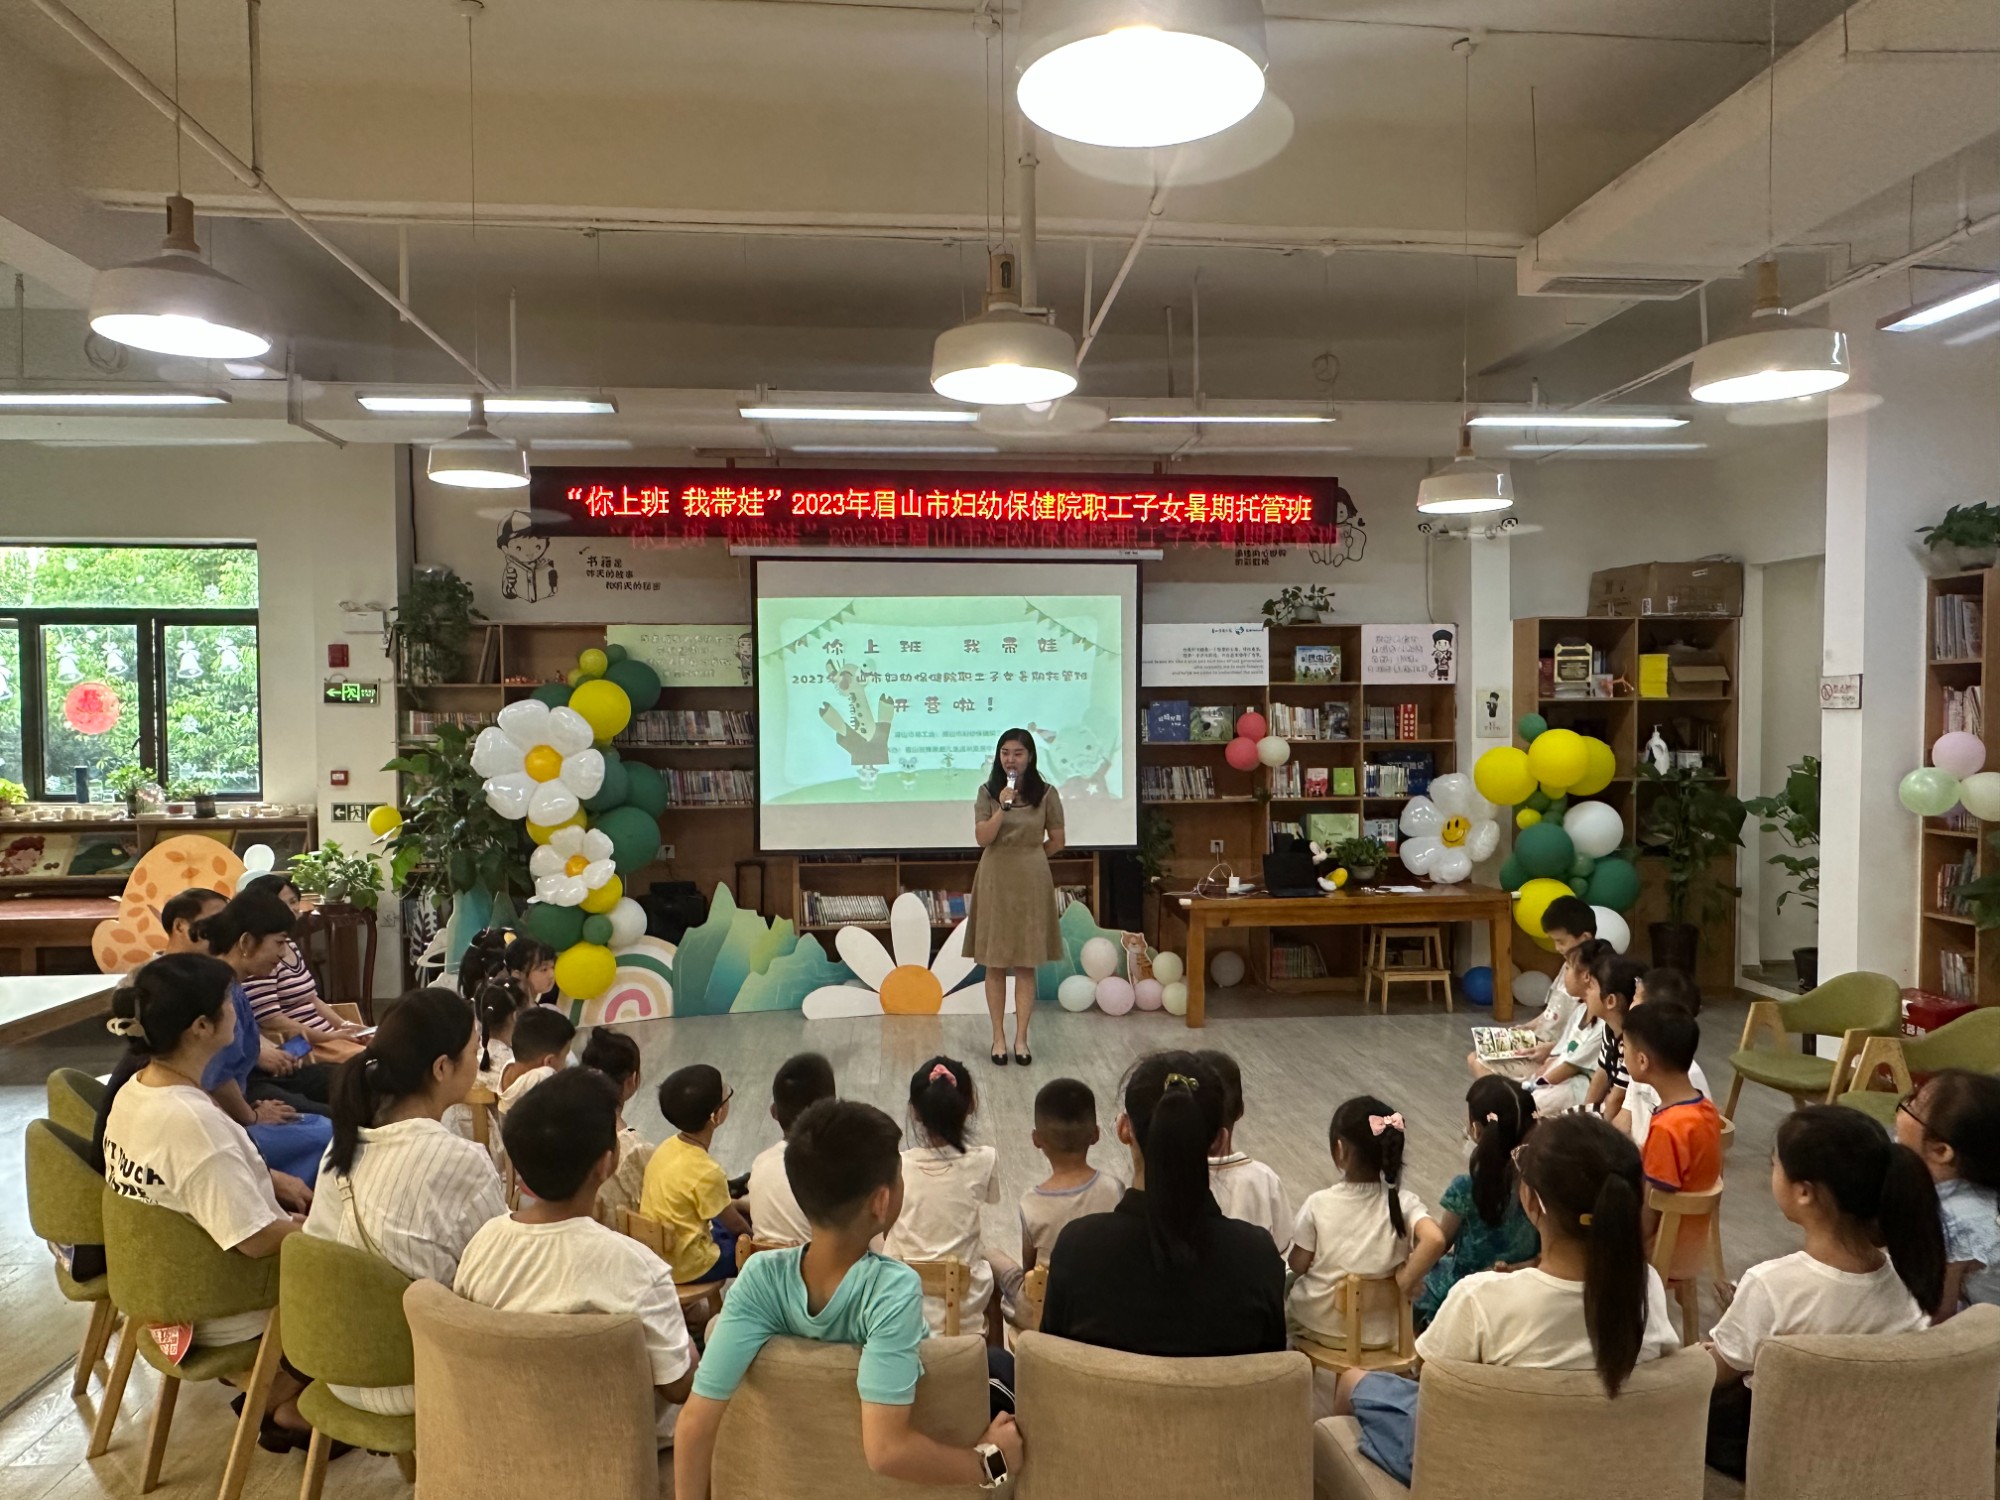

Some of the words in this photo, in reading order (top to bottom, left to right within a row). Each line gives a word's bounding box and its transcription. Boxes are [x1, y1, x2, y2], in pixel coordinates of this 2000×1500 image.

[791, 489, 1312, 524] 2023年眉山市妇幼保健院职工子女暑期托管班
[792, 670, 1088, 684] 2023山市妇幼保健院职工子女暑期托管班
